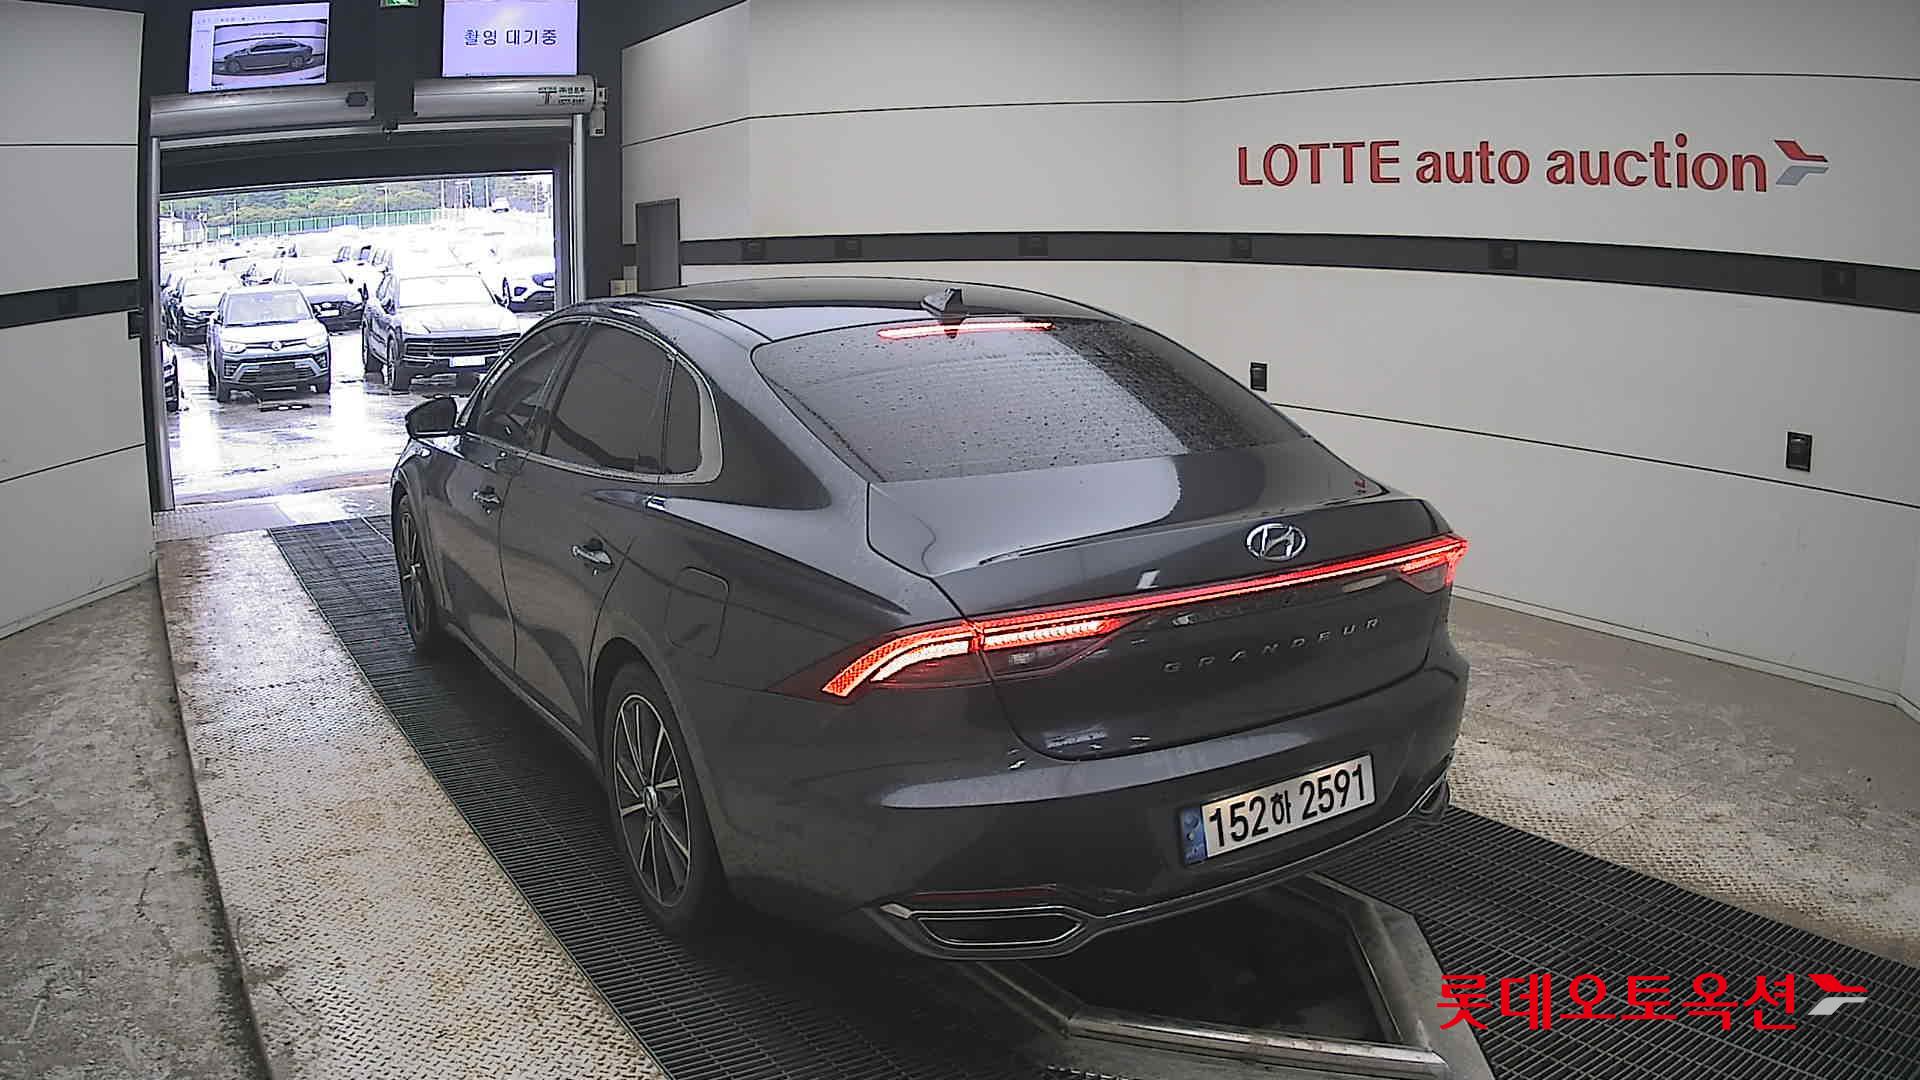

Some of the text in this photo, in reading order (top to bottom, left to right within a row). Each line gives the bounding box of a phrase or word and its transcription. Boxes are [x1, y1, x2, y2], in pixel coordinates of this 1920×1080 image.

[464, 29, 557, 46] 촬영 대기중
[1238, 133, 1768, 192] LOTTE auto auction
[1163, 617, 1379, 672] GRANDEUR
[1209, 764, 1366, 847] 152하 2591
